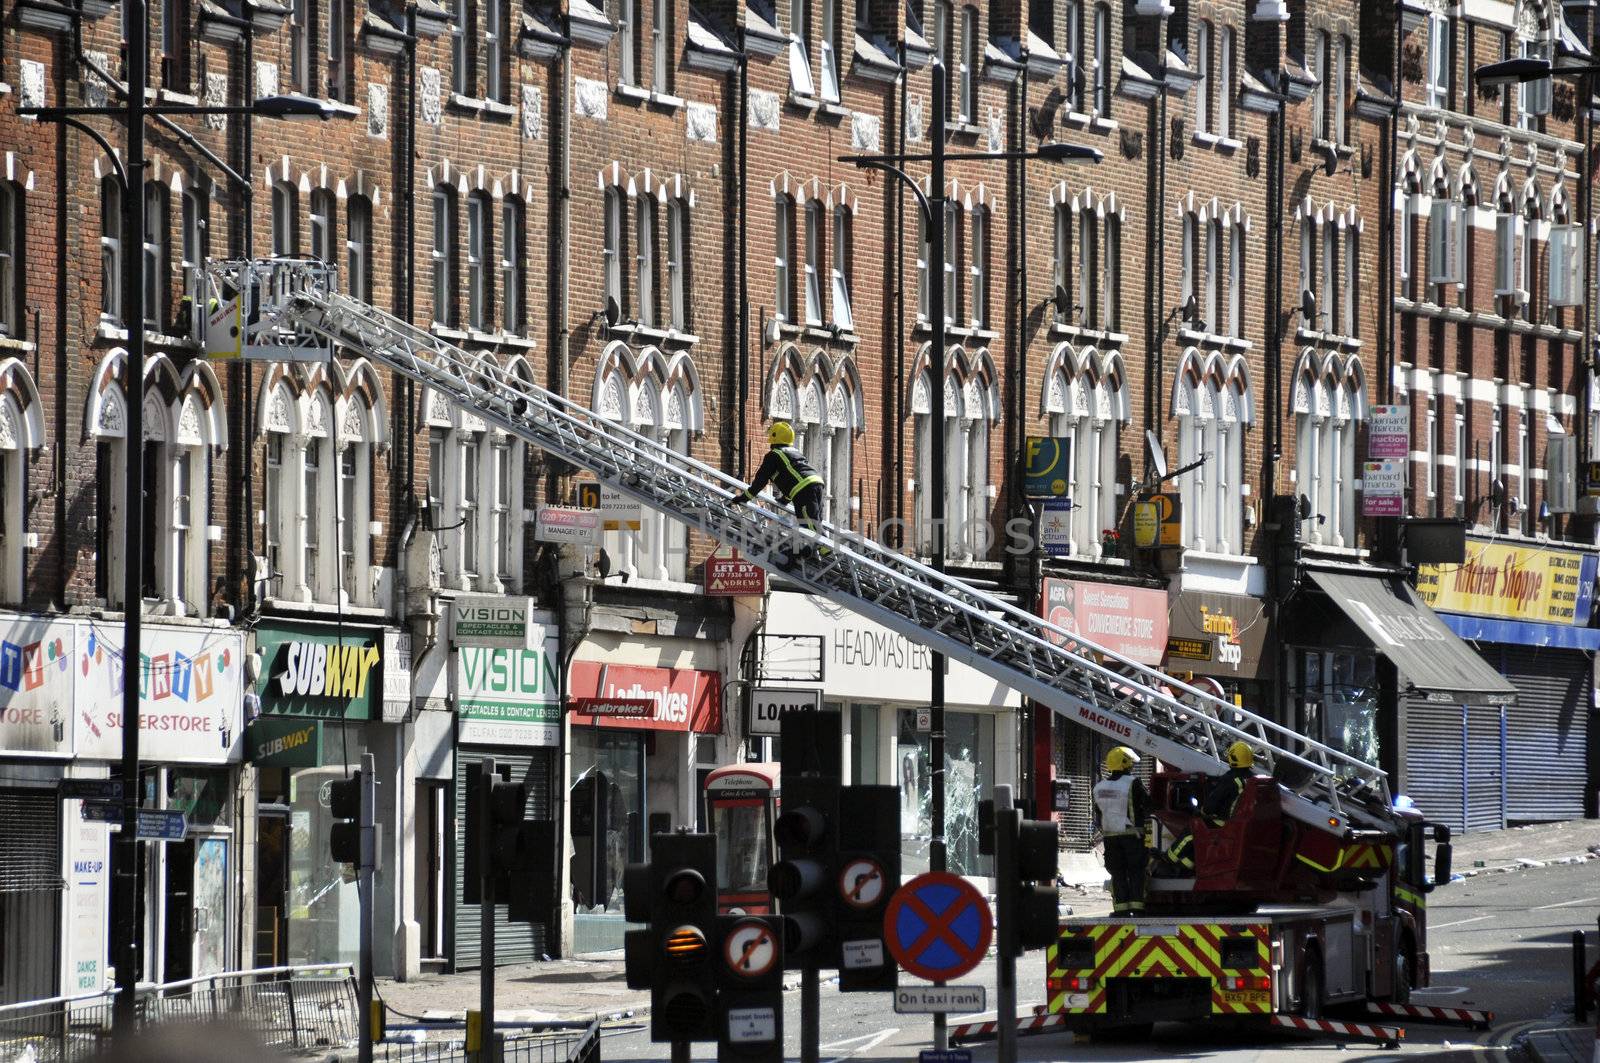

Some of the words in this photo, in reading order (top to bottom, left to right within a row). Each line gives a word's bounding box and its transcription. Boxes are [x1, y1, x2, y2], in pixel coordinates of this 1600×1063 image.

[1499, 552, 1543, 611] Shoppe
[458, 607, 525, 621] VISION
[280, 641, 380, 697] SUBWAY
[461, 648, 560, 695] VISION
[460, 705, 499, 716] SPECTACLES
[506, 708, 535, 717] CONTACT
[536, 709, 560, 718] LENSES
[586, 703, 645, 714] Ladbrokes
[106, 712, 211, 732] SUERSTORE
[1079, 707, 1132, 738] MAGIRUS
[257, 726, 316, 760] SUBWAY
[724, 778, 754, 786] Telephone
[74, 861, 103, 873] MAKE-UP
[77, 960, 97, 973] DANCE
[78, 975, 97, 989] WEAR
[899, 993, 918, 1004] On
[922, 992, 948, 1004] taxi
[951, 993, 980, 1004] rank
